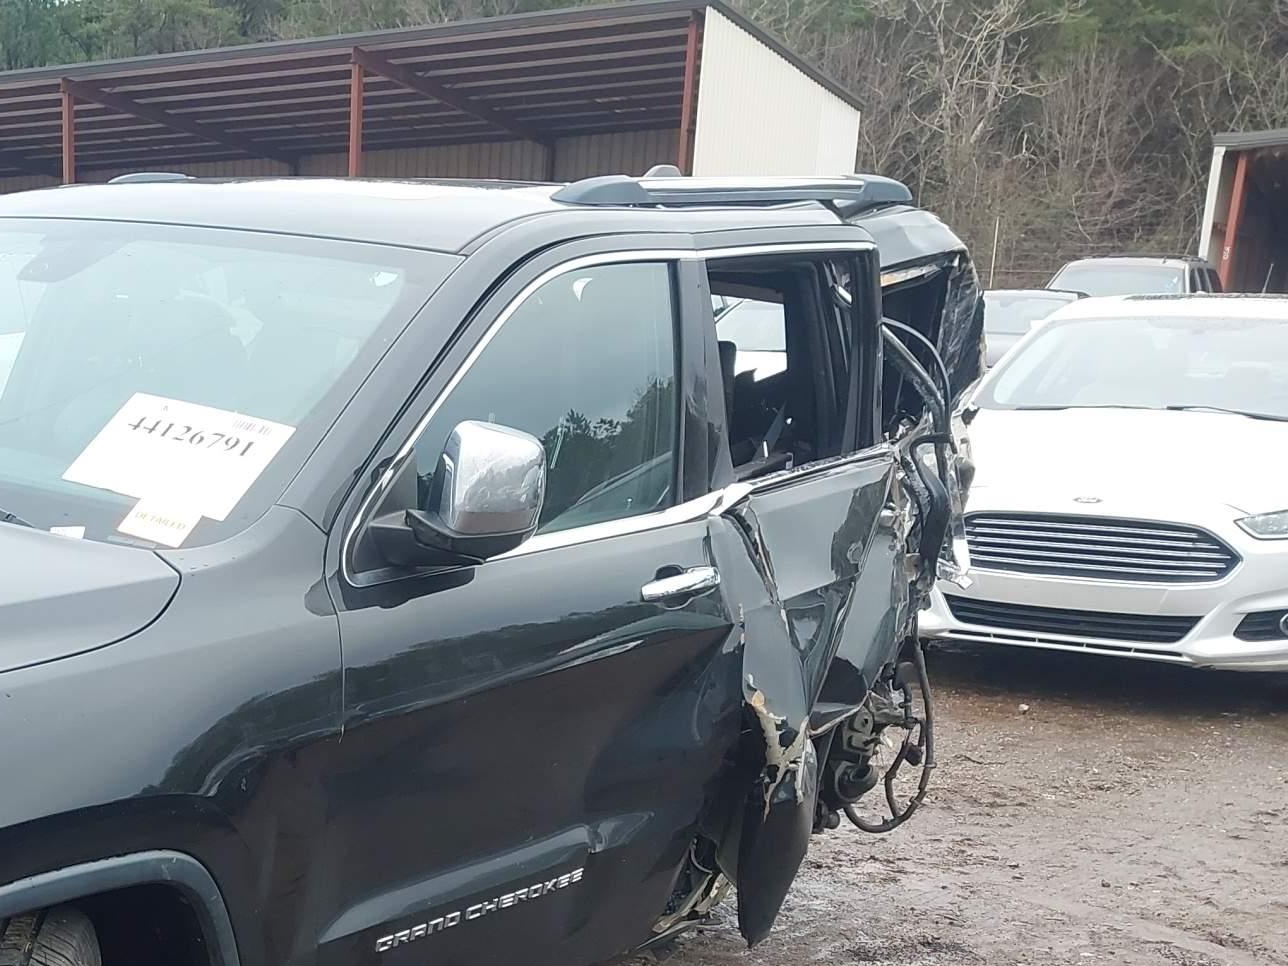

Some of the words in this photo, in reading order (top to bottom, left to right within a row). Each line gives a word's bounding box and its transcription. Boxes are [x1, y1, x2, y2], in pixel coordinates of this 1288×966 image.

[128, 416, 255, 457] 44126791
[375, 911, 461, 952] GRAND
[465, 867, 585, 921] CHEROKEE
